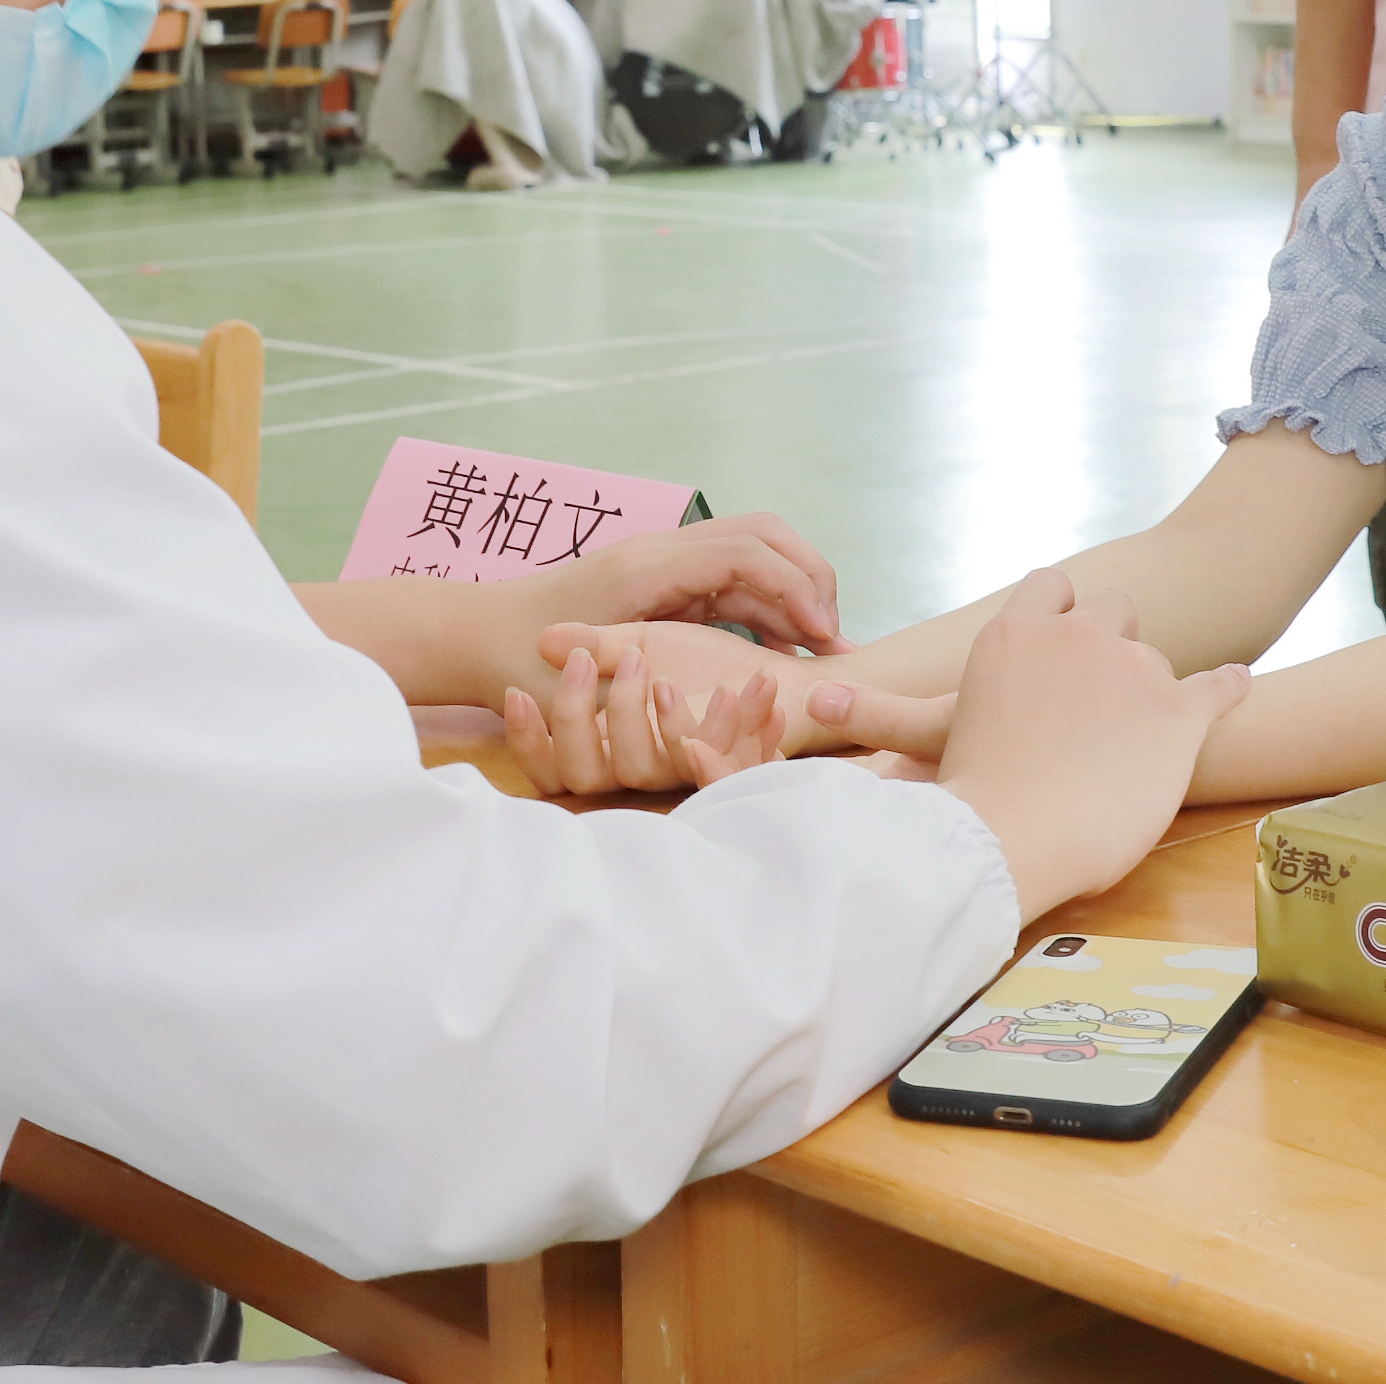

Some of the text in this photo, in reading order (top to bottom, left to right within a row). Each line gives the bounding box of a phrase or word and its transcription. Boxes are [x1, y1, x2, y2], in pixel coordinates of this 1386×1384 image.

[406, 461, 623, 566] 黄柏文
[1270, 847, 1335, 888] 洁柔
